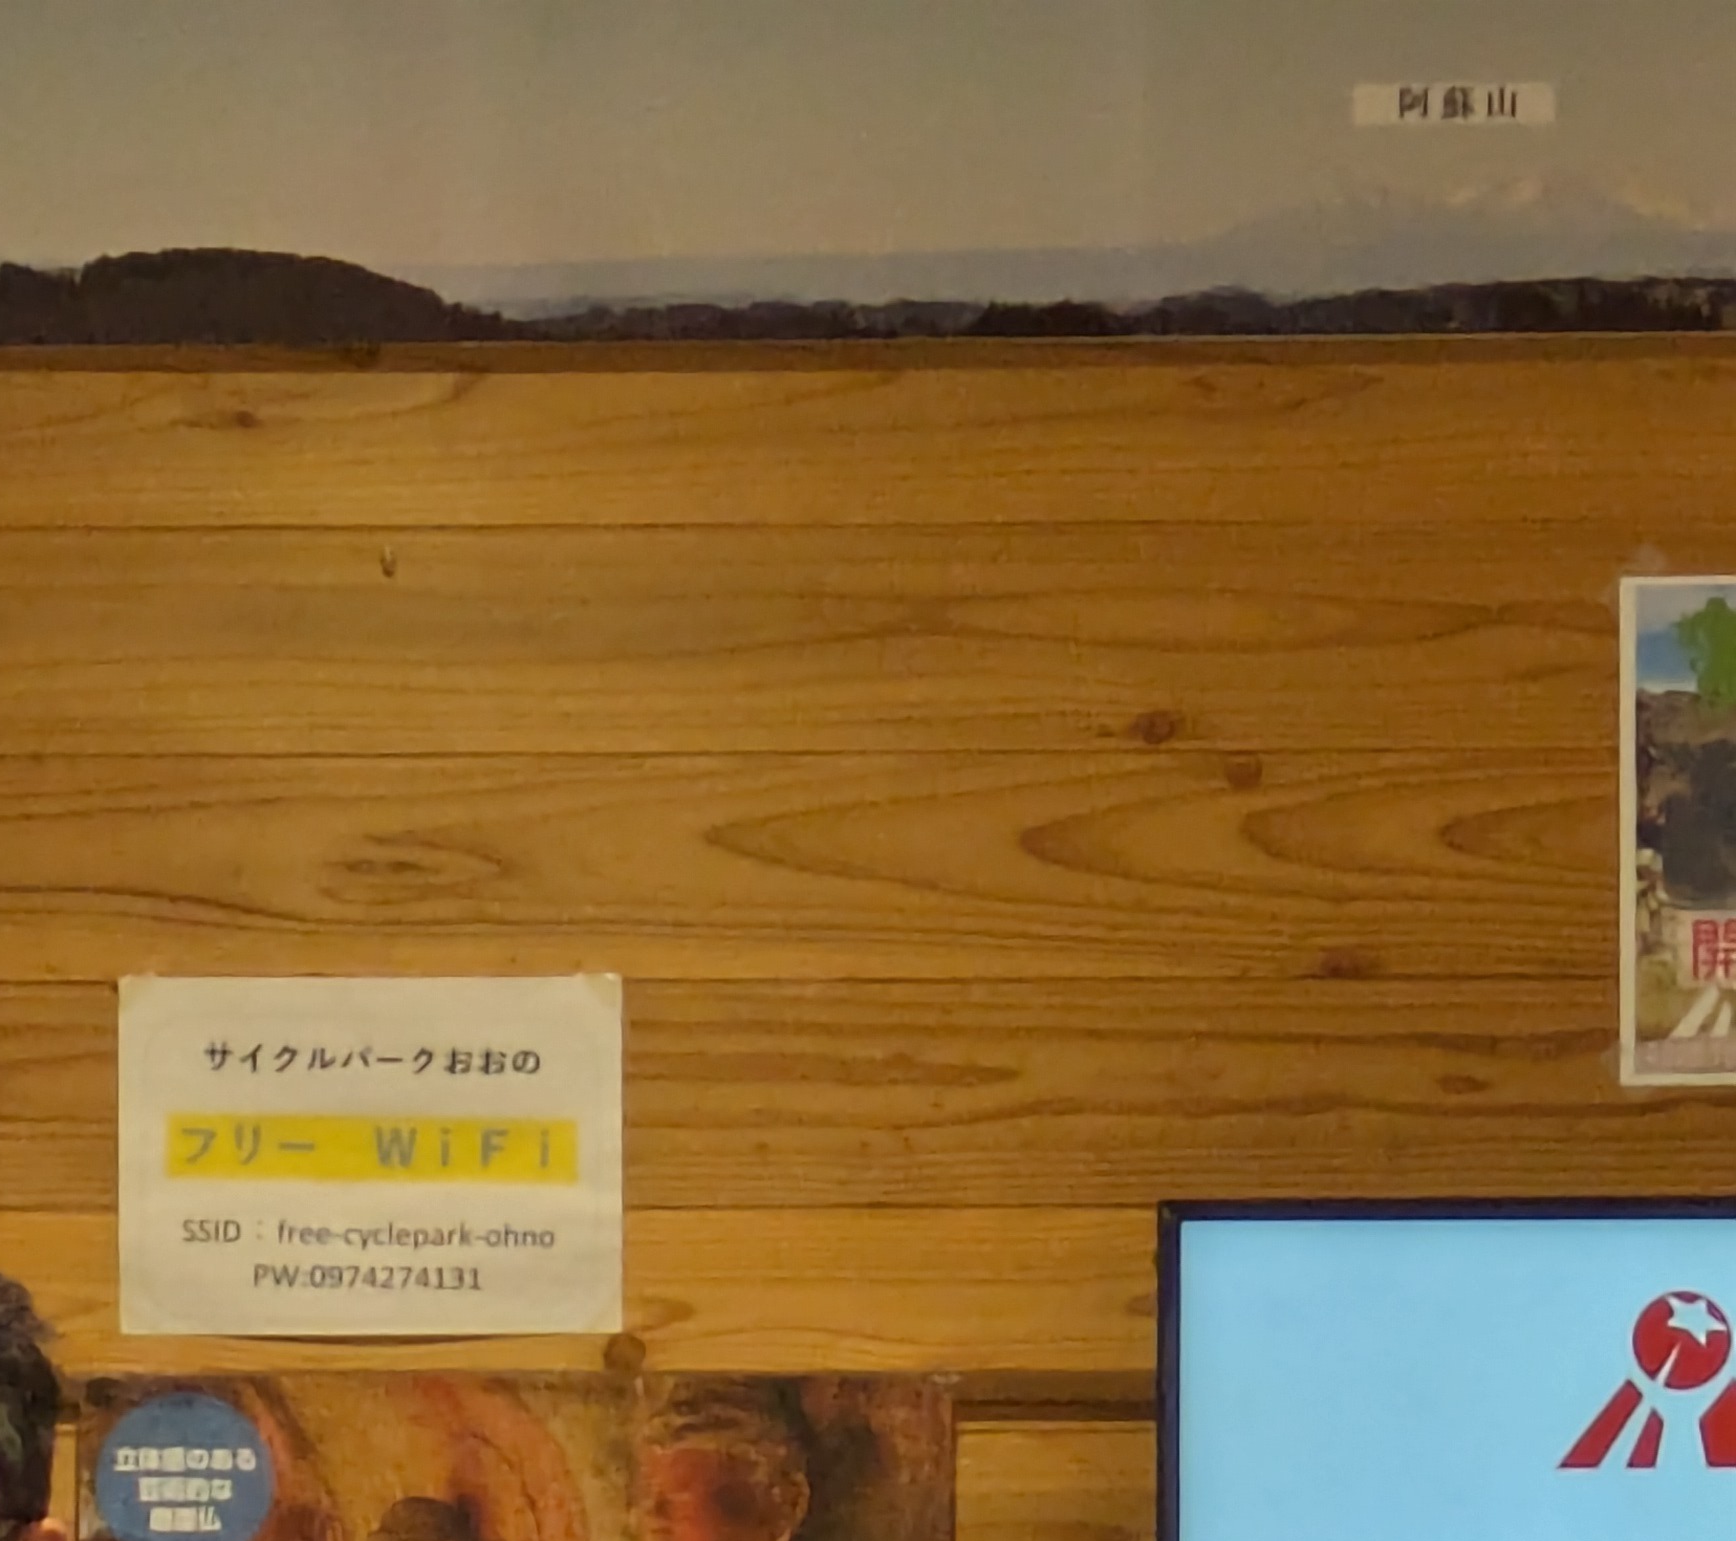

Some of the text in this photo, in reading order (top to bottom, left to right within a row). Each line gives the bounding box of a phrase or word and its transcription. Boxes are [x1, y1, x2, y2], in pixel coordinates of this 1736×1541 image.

[1398, 85, 1518, 119] 阿蘇山
[204, 1042, 541, 1075] サイクルパークおおの
[180, 1123, 551, 1168] フリー WiFi
